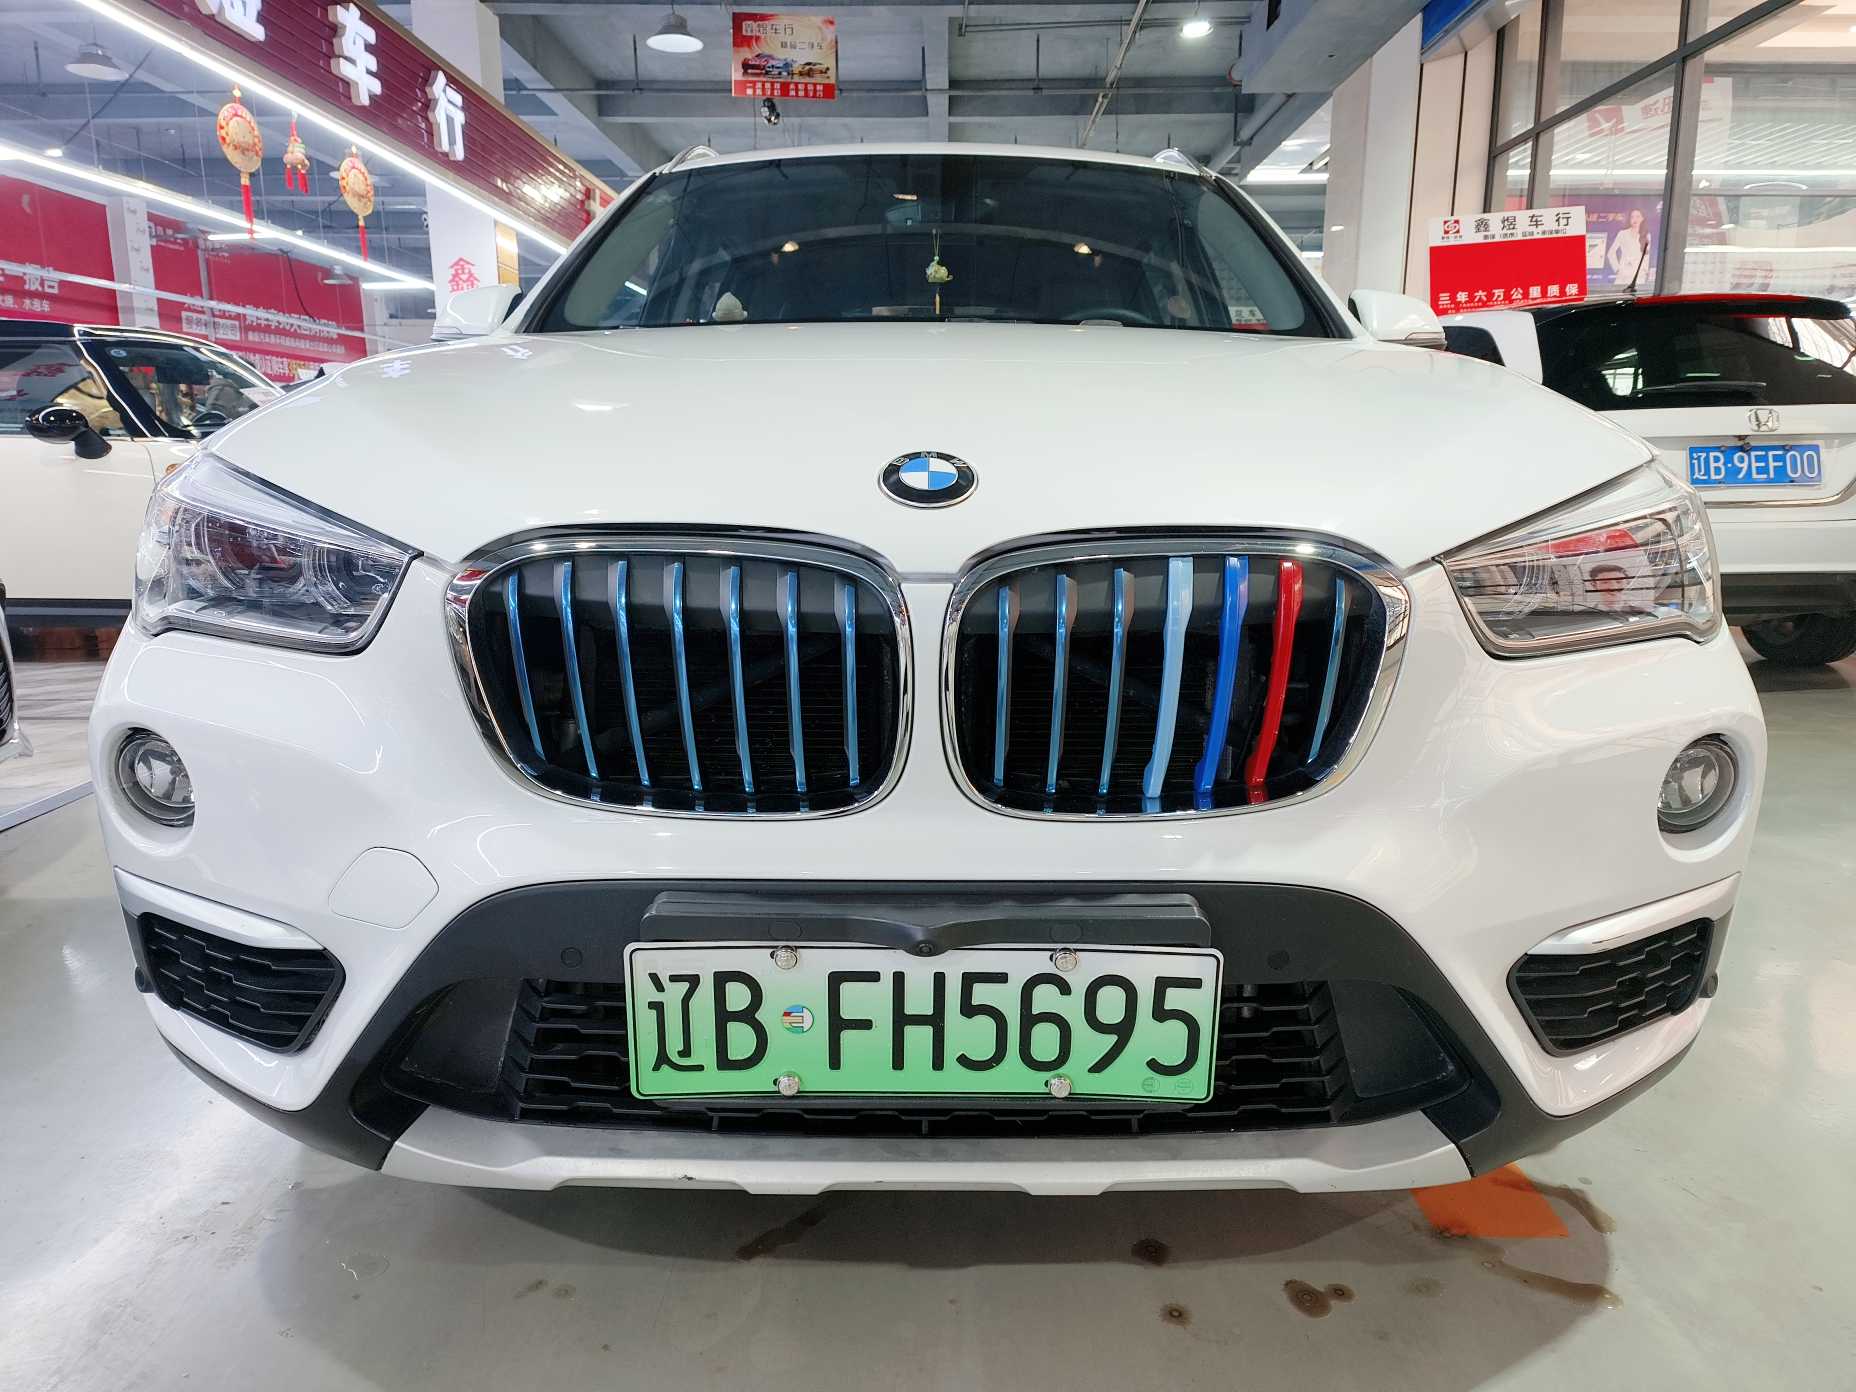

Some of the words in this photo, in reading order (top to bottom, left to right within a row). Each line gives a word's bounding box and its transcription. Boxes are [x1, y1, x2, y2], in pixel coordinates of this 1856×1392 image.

[1474, 211, 1572, 233] 鑫煜车行
[1438, 284, 1579, 304] 三年六万公里质保
[648, 970, 769, 1072] 辽B
[827, 970, 1203, 1076] FH5695
